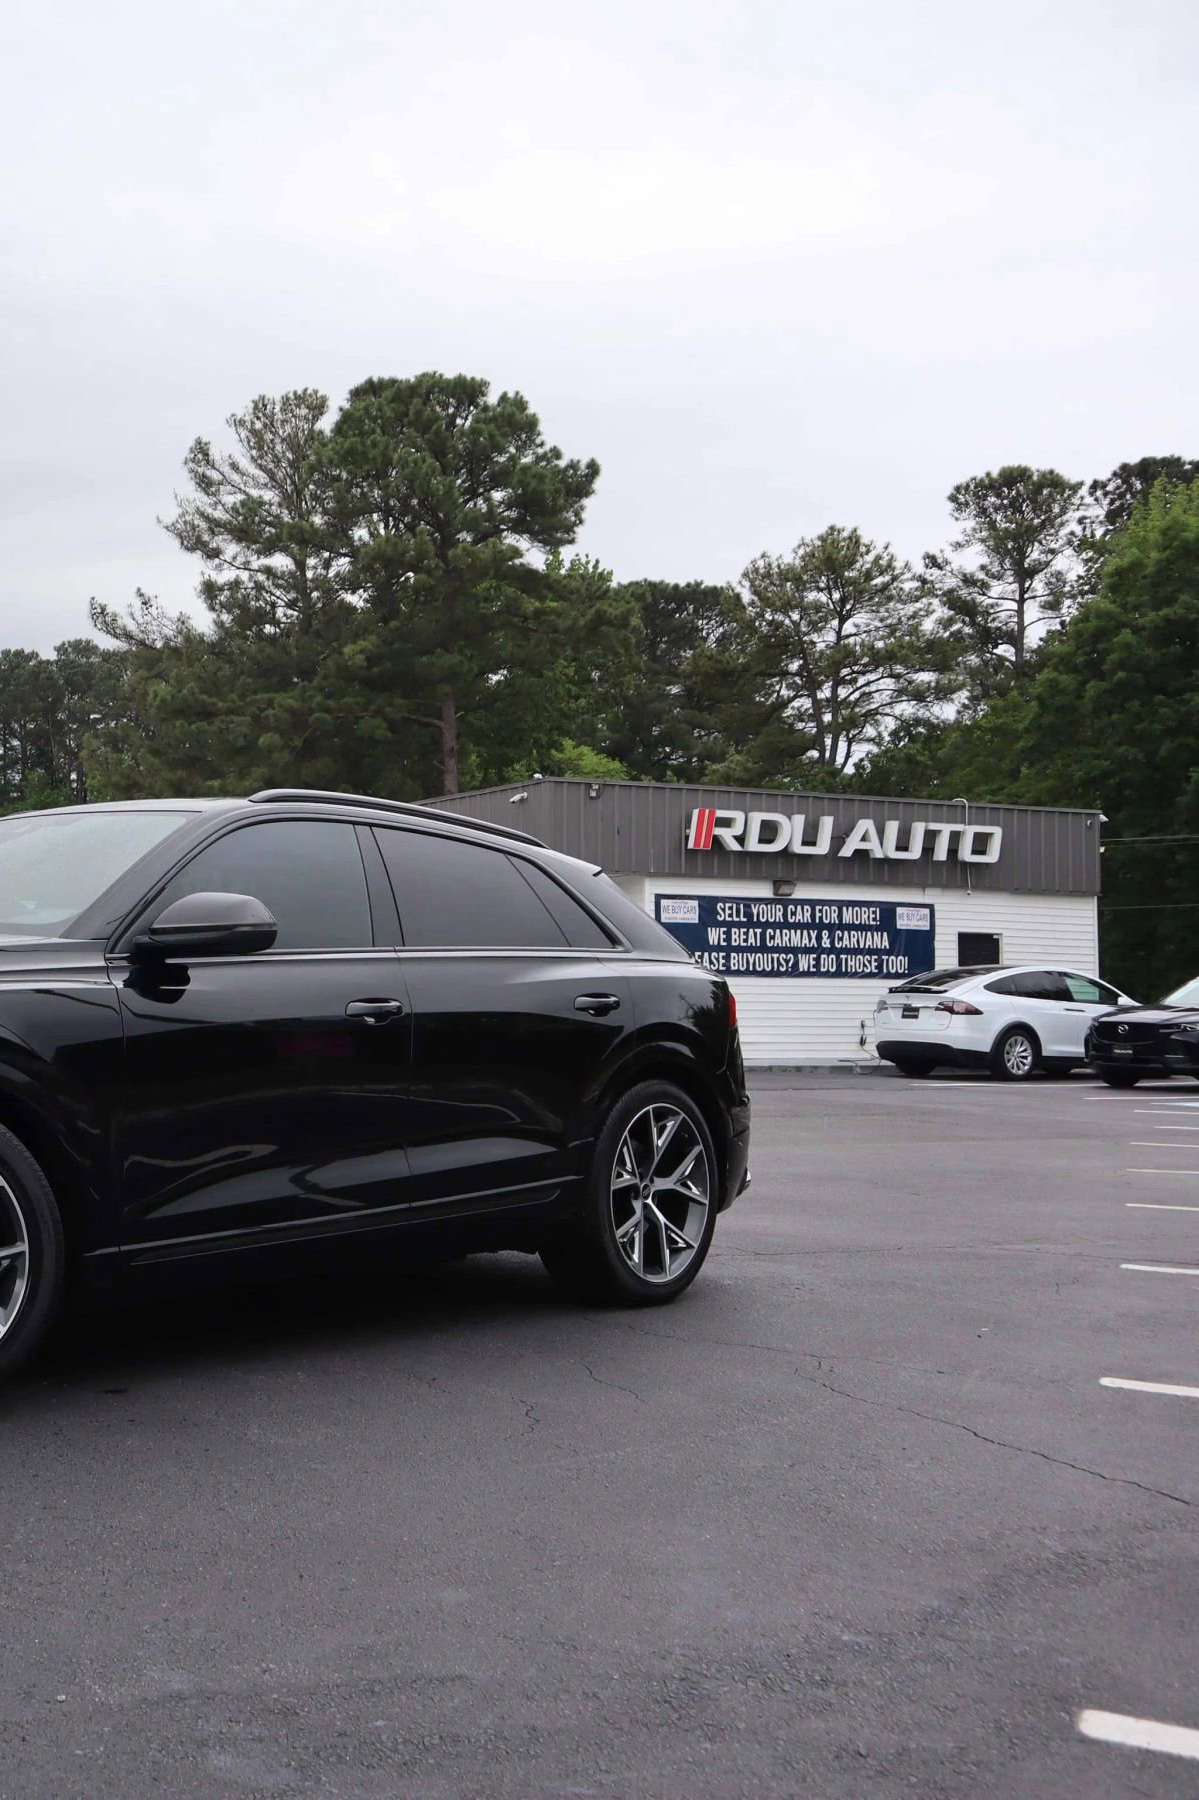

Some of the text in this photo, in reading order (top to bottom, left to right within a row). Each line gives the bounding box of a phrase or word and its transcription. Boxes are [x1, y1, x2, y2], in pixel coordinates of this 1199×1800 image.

[703, 808, 1001, 864] RDU AUTO
[662, 904, 697, 915] WE BUY CARS
[716, 902, 880, 925] SELL YOUR CAR FOR MORE!
[707, 926, 889, 950] WE BEAT CARMAX & CARVANA
[730, 952, 794, 972] BUYOUTS?
[798, 953, 817, 973] WE
[820, 953, 837, 973] DO
[840, 954, 879, 974] THOSE
[881, 955, 909, 974] TOO!
